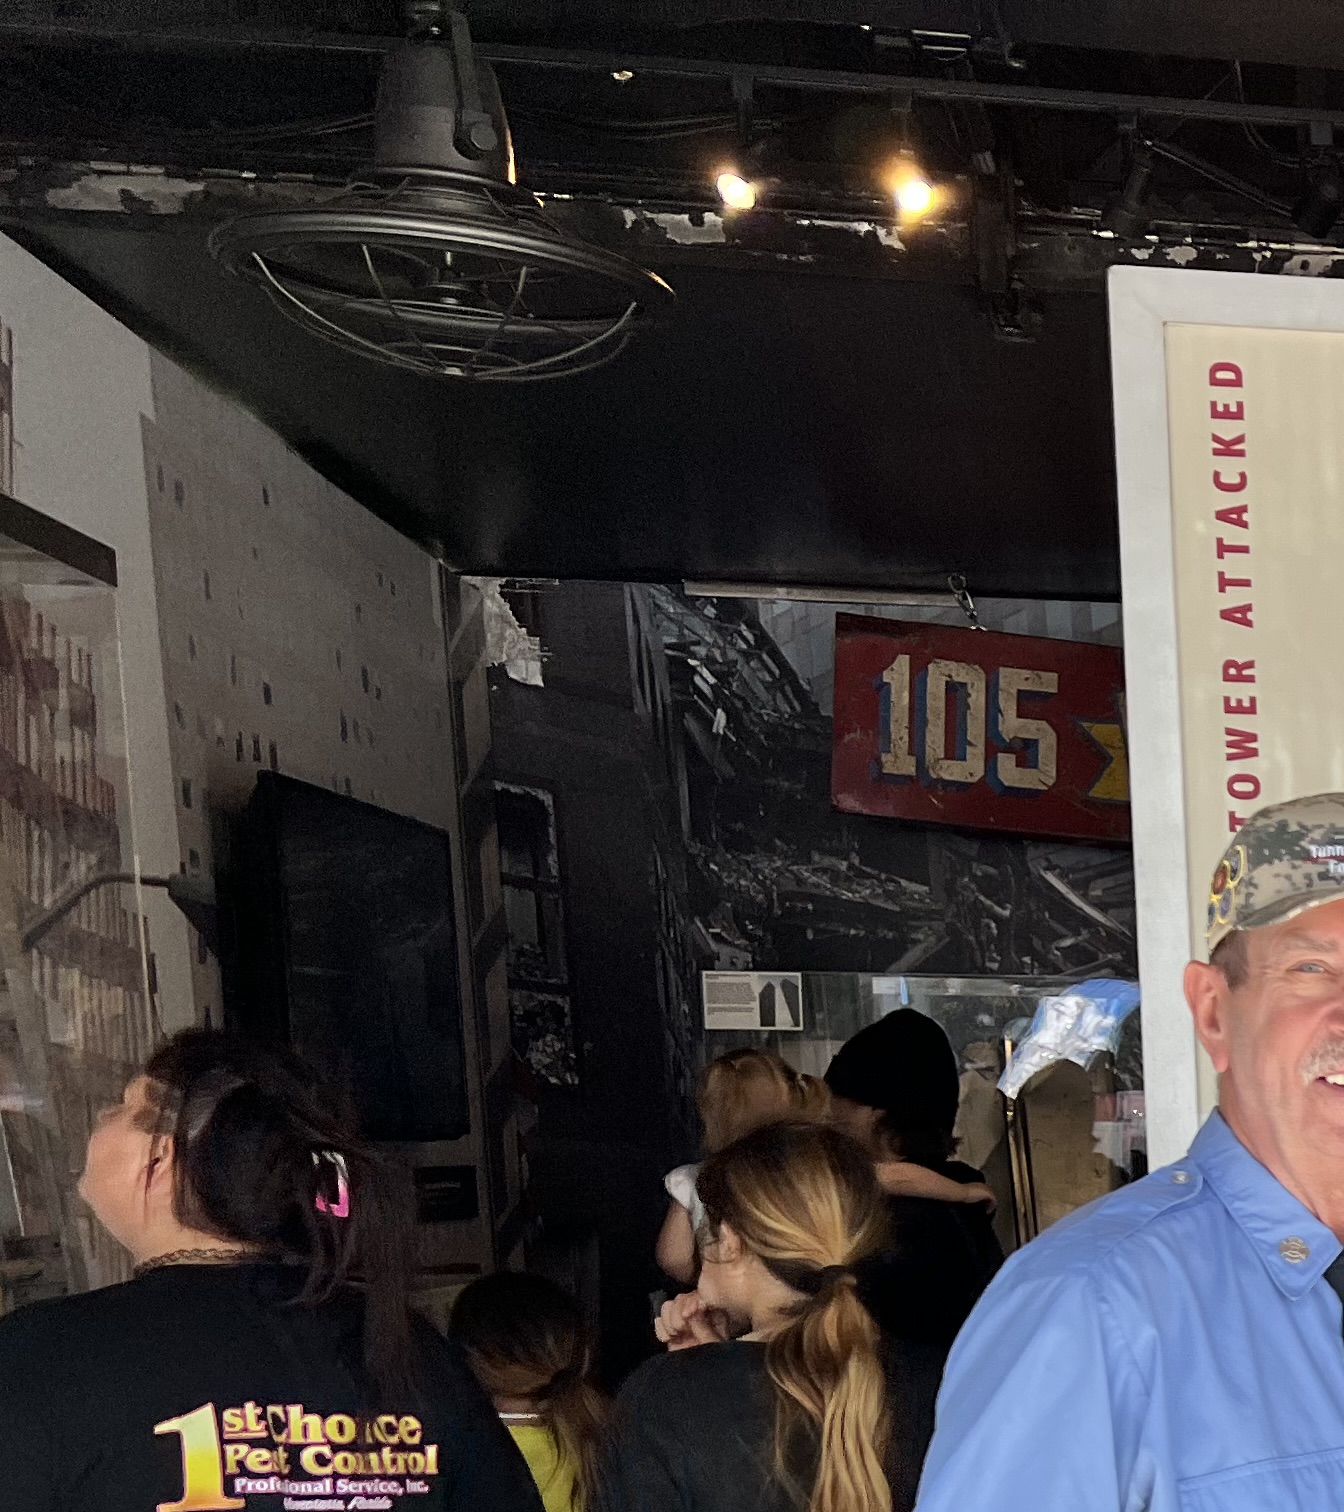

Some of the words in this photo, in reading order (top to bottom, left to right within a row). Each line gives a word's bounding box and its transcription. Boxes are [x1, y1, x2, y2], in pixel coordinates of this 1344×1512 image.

[1210, 362, 1253, 628] ATTACKED
[880, 653, 1059, 791] 105
[1223, 660, 1261, 832] TOWER
[267, 1403, 422, 1444] Choce
[336, 1479, 404, 1496] Service,
